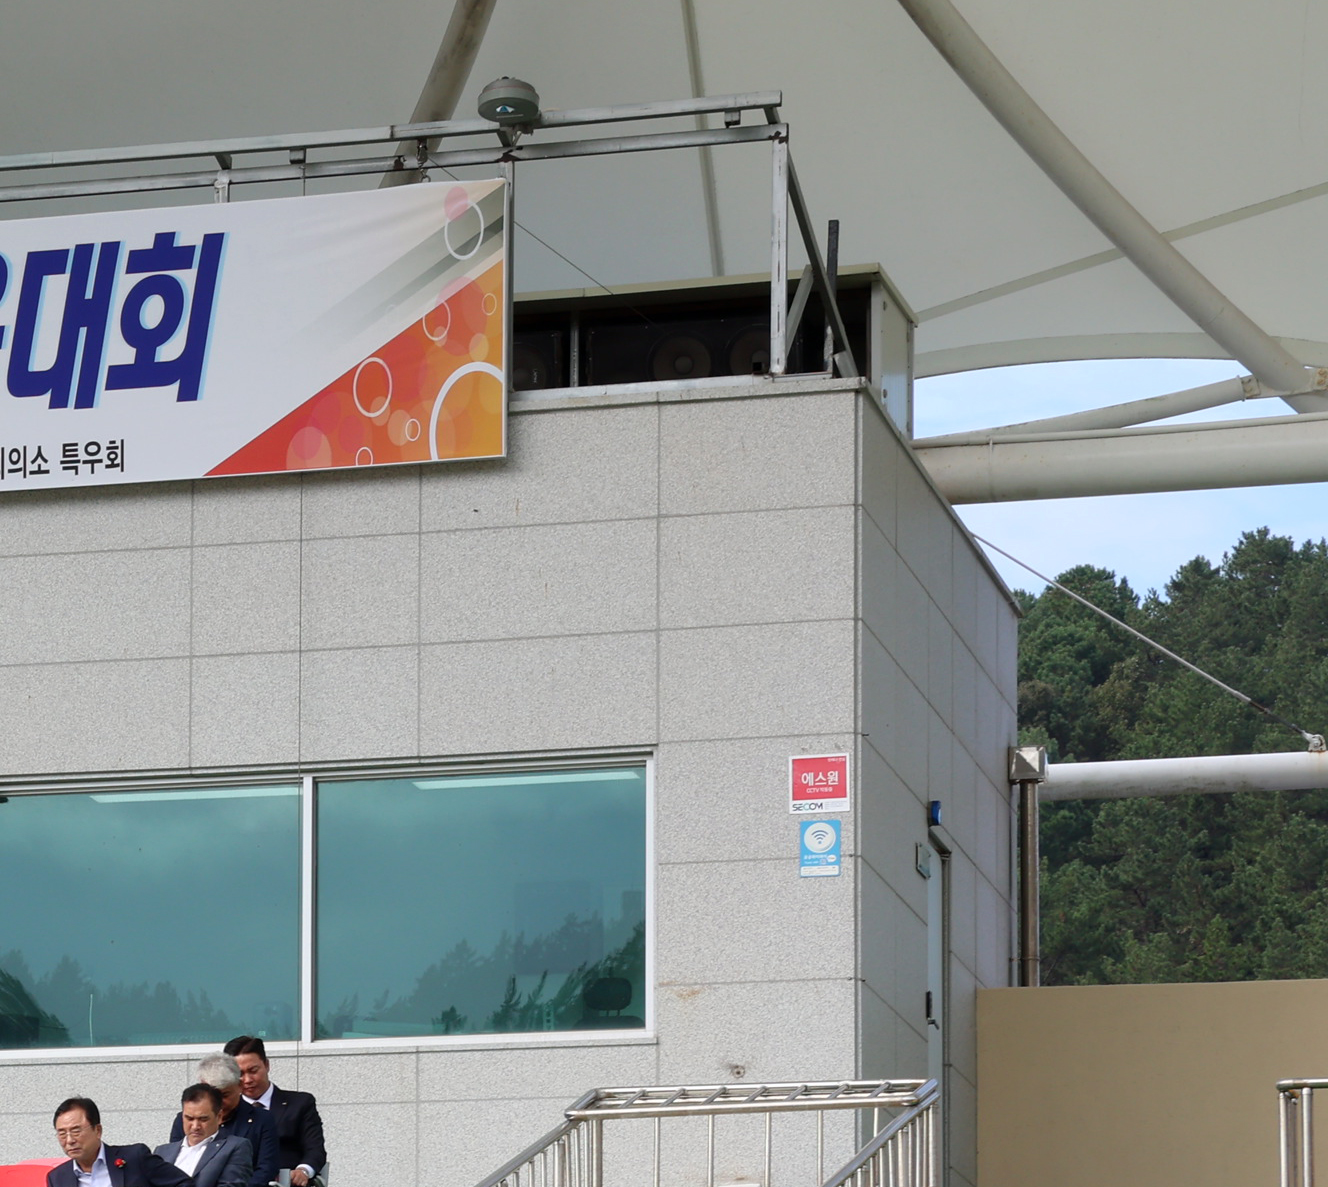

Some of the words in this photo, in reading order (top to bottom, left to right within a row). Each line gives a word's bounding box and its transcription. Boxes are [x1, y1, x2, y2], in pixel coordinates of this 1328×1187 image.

[59, 437, 126, 477] 특우회
[801, 770, 839, 786] 에스원
[792, 802, 823, 811] SECOM
